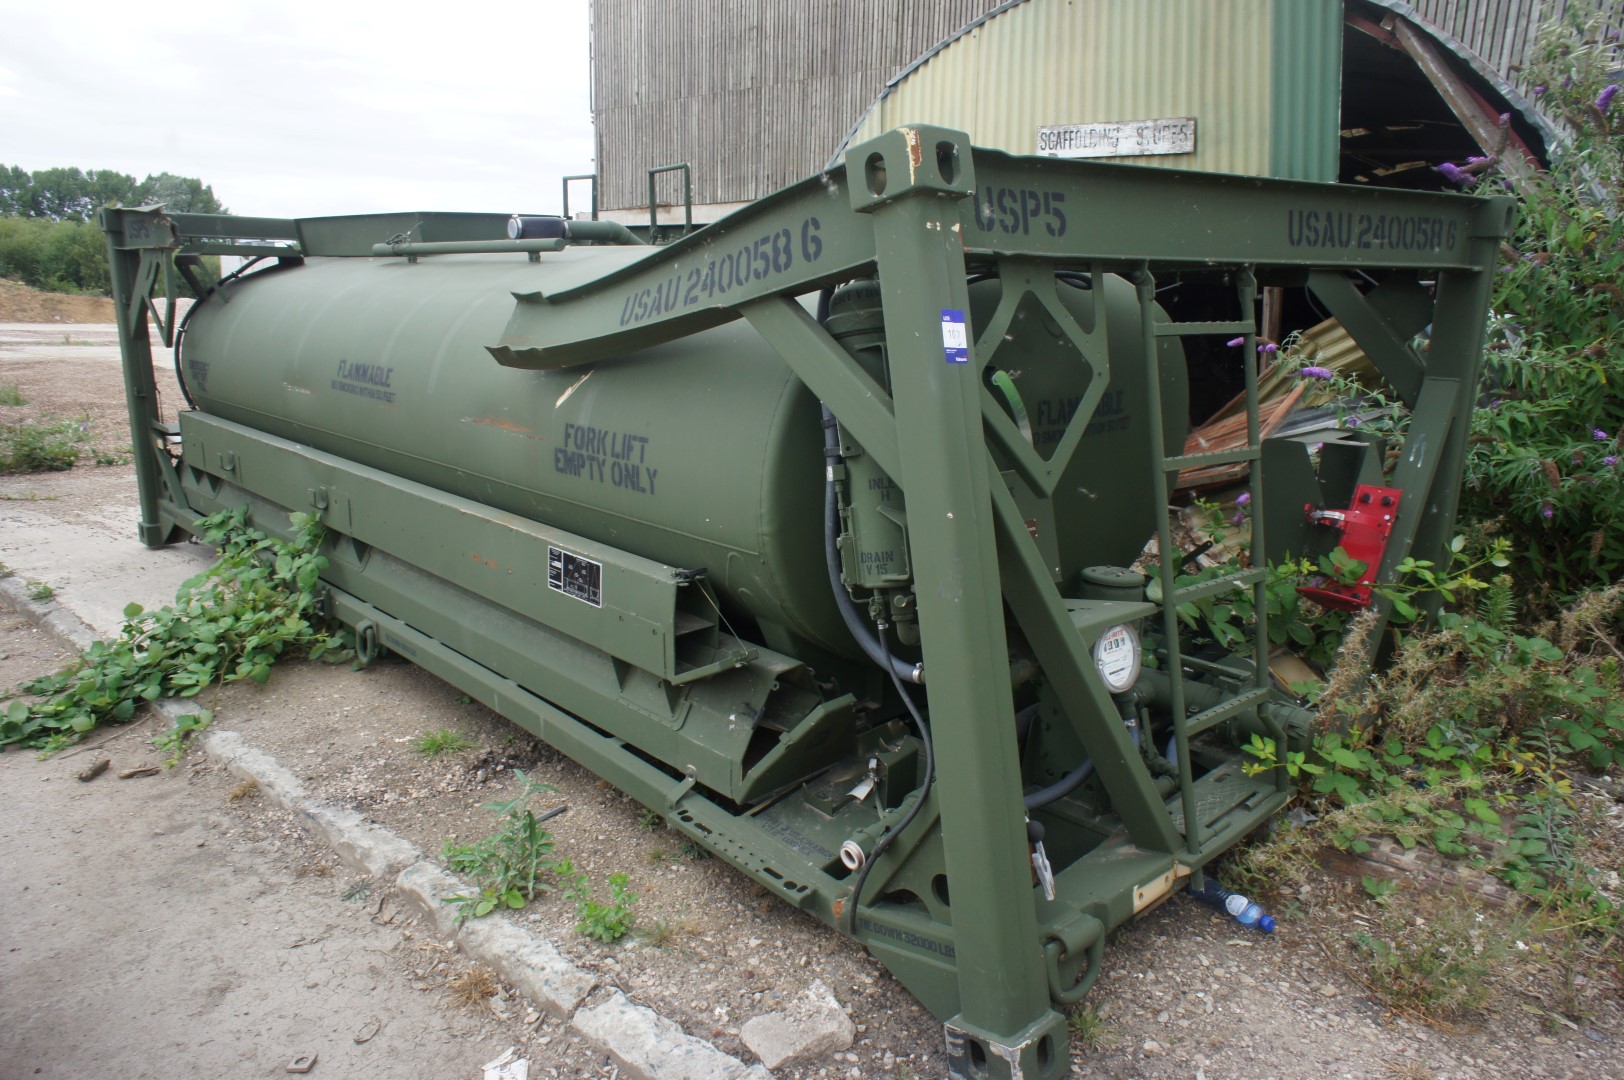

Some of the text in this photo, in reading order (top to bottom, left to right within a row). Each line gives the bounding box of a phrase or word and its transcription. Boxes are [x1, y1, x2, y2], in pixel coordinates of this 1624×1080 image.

[972, 184, 1067, 238] USP5
[1288, 209, 1353, 248] USAU
[1357, 213, 1444, 251] 240058
[619, 274, 682, 327] USAU
[683, 228, 794, 307] 240058
[337, 359, 394, 388] FLAMMABLE
[564, 423, 649, 464] FORK LIFT
[554, 447, 658, 495] EMPTY ONLY
[860, 550, 894, 563] DRAIN
[876, 563, 888, 575] 15
[873, 922, 902, 942] DOWN
